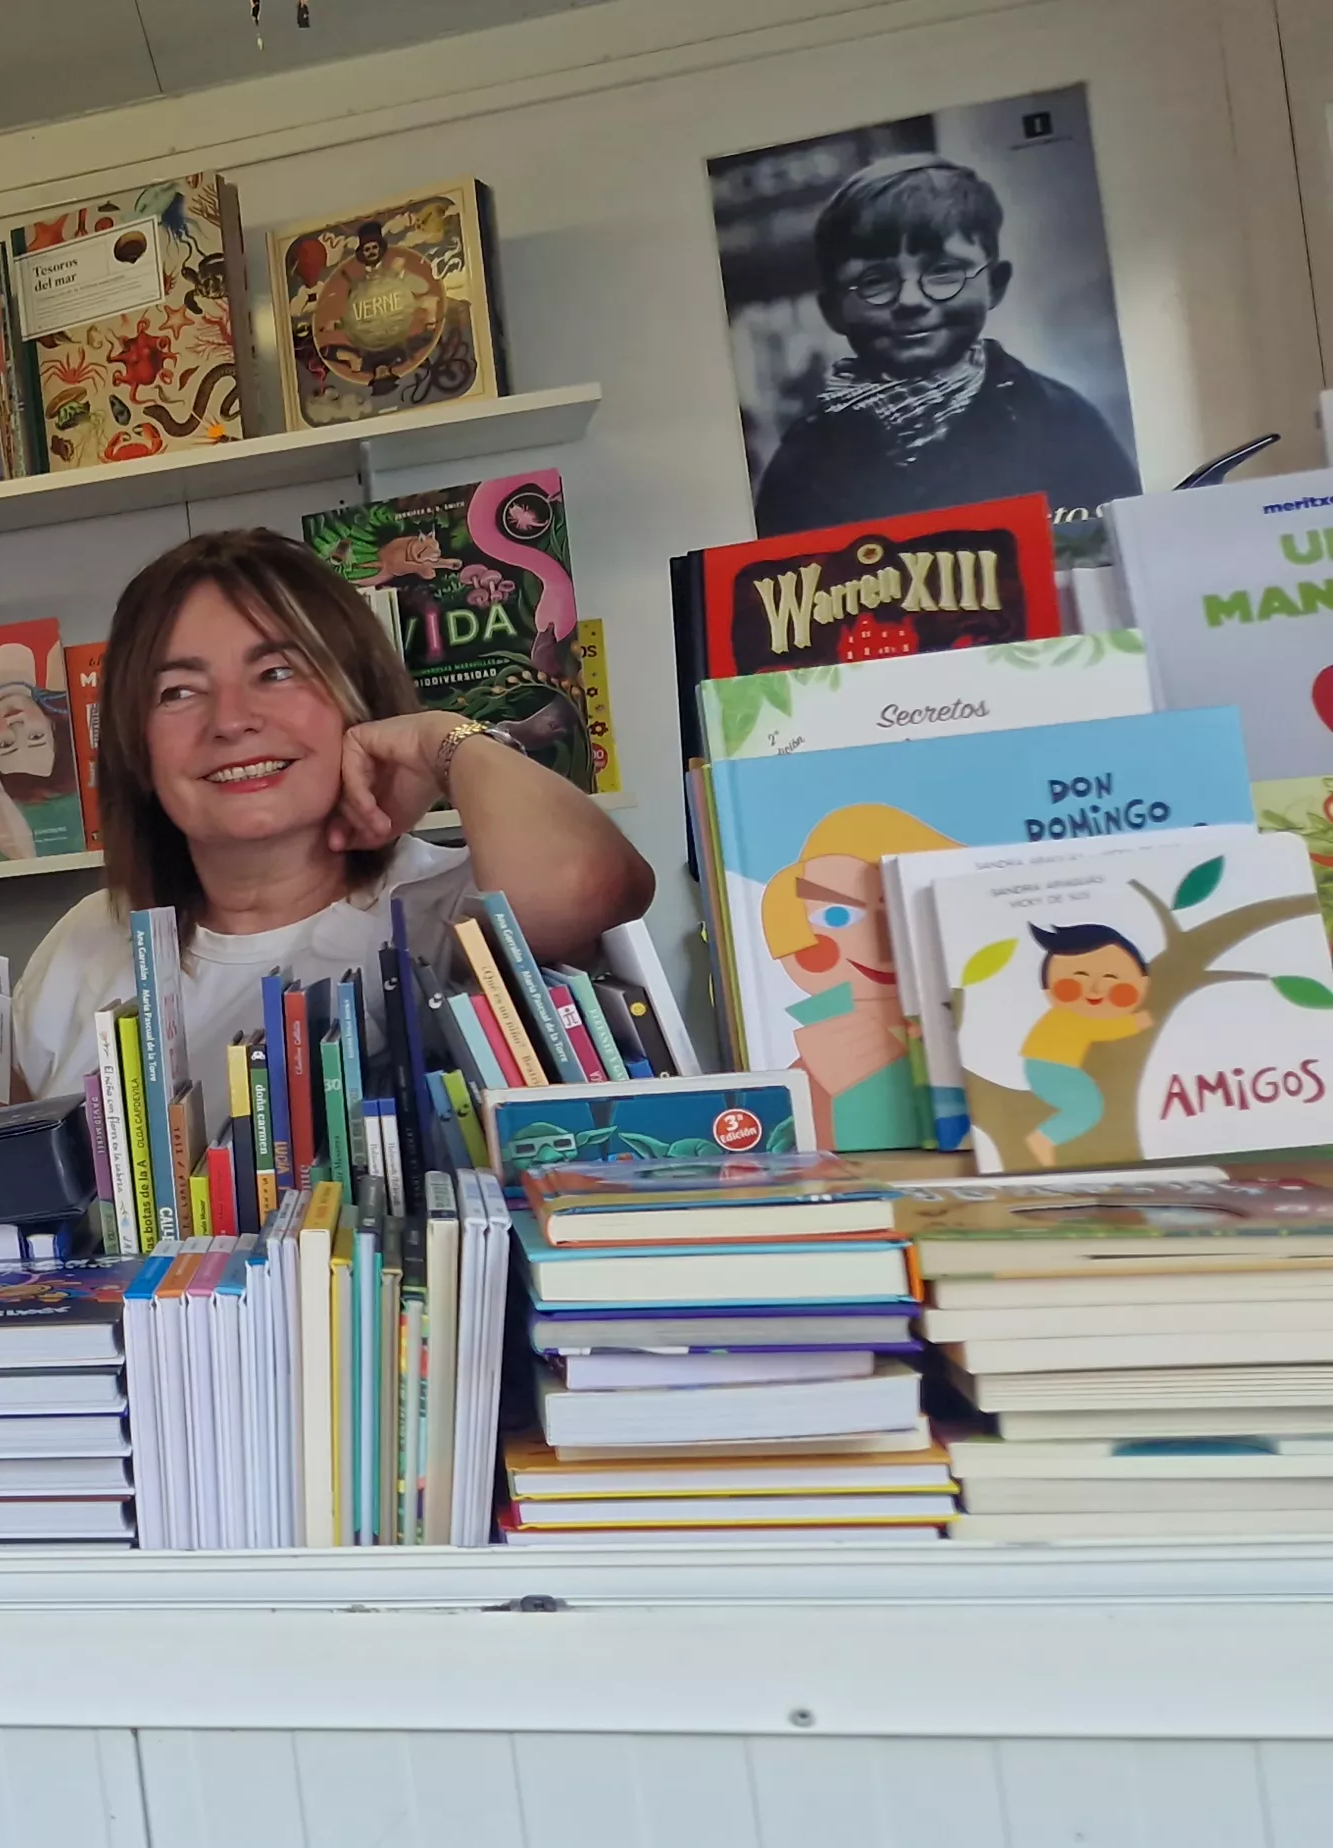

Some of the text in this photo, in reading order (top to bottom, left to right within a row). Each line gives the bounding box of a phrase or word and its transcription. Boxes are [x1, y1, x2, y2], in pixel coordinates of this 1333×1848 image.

[33, 258, 79, 279] Tesoros
[34, 273, 77, 293] del mar
[353, 293, 403, 321] VERNE
[754, 549, 1002, 654] Warren XIII
[876, 698, 990, 728] Secretos
[1047, 772, 1114, 804] DON
[991, 880, 1040, 897] SANDRA
[136, 930, 147, 946] Ana
[137, 946, 150, 980] Garralón
[494, 913, 505, 929] Ana
[501, 929, 524, 963] Garralón
[521, 970, 536, 994] María
[530, 991, 551, 1027] Pascual
[553, 1044, 570, 1064] Torre
[140, 989, 151, 1012] María
[143, 1012, 155, 1041] Pascual
[146, 1042, 156, 1051] de
[103, 1065, 113, 1075] El
[148, 1061, 158, 1081] Torre
[104, 1076, 114, 1096] niño
[324, 1078, 342, 1092] 30
[91, 1096, 101, 1127] DAVID
[107, 1099, 116, 1114] con
[131, 1077, 143, 1124] CAPDEVILA
[108, 1116, 122, 1140] flores
[255, 1084, 268, 1155] doña carmen
[134, 1125, 145, 1149] OLGA
[720, 1126, 757, 1145] Edición
[136, 1160, 147, 1169] A
[138, 1170, 148, 1181] la
[114, 1163, 124, 1194] cabeza
[139, 1184, 150, 1198] de
[140, 1201, 154, 1234] botas
